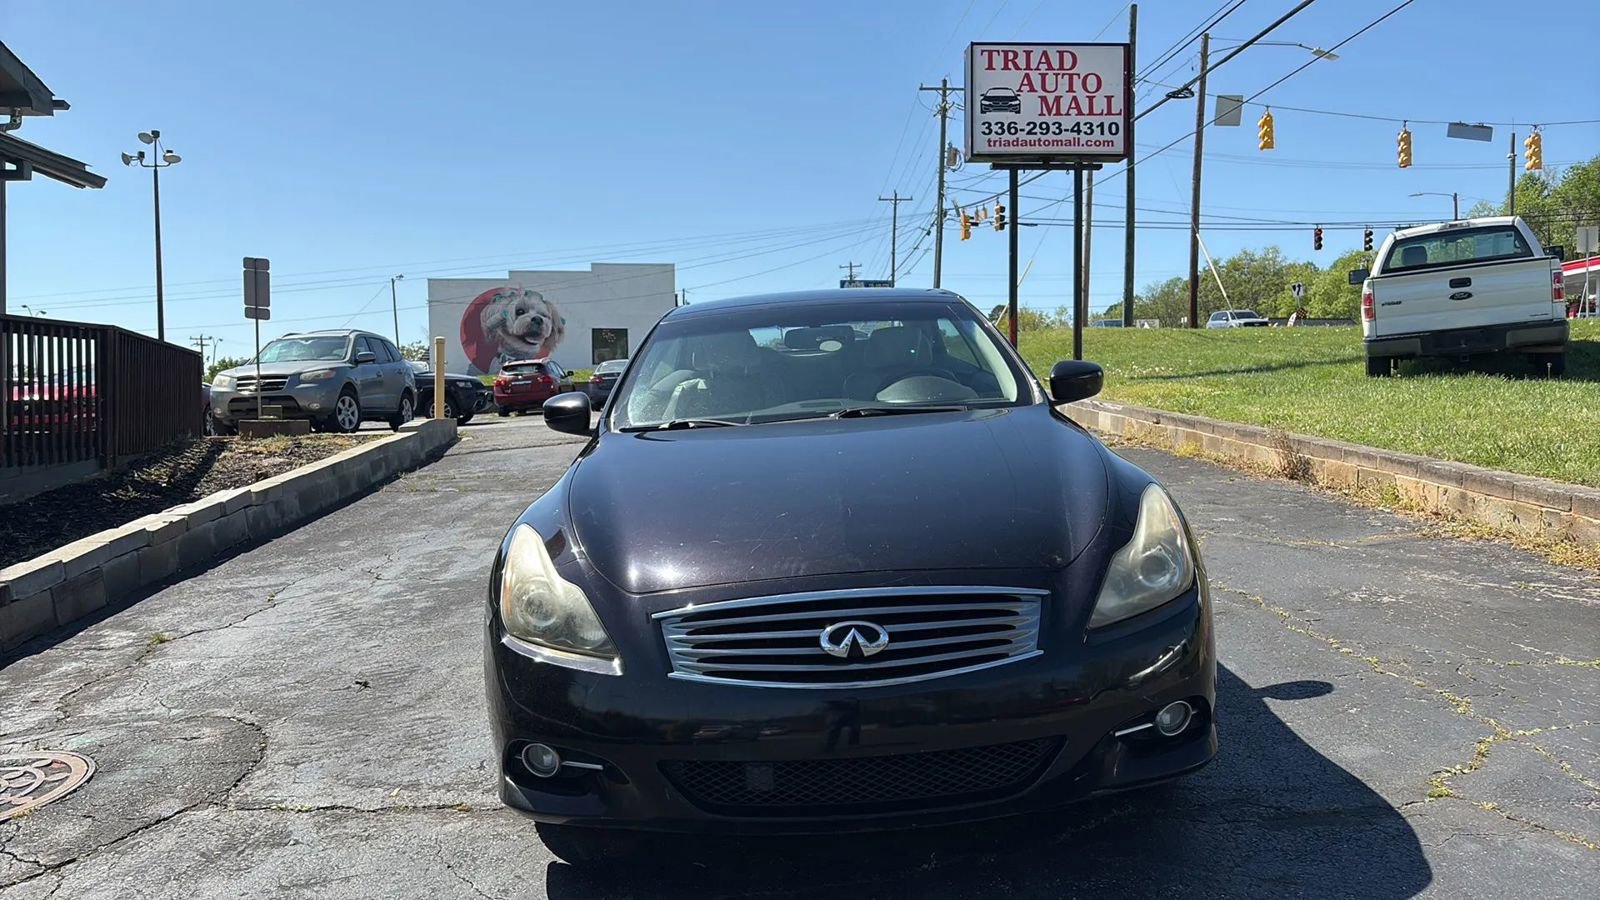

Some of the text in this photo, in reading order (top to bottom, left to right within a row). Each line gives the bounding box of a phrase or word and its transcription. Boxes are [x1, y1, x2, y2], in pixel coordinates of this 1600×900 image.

[980, 50, 1078, 71] TRIAD
[1016, 73, 1103, 93] AUTO
[1038, 95, 1122, 116] MALL
[981, 121, 1120, 136] 336-293-4310
[987, 137, 1115, 148] triadautomall.com
